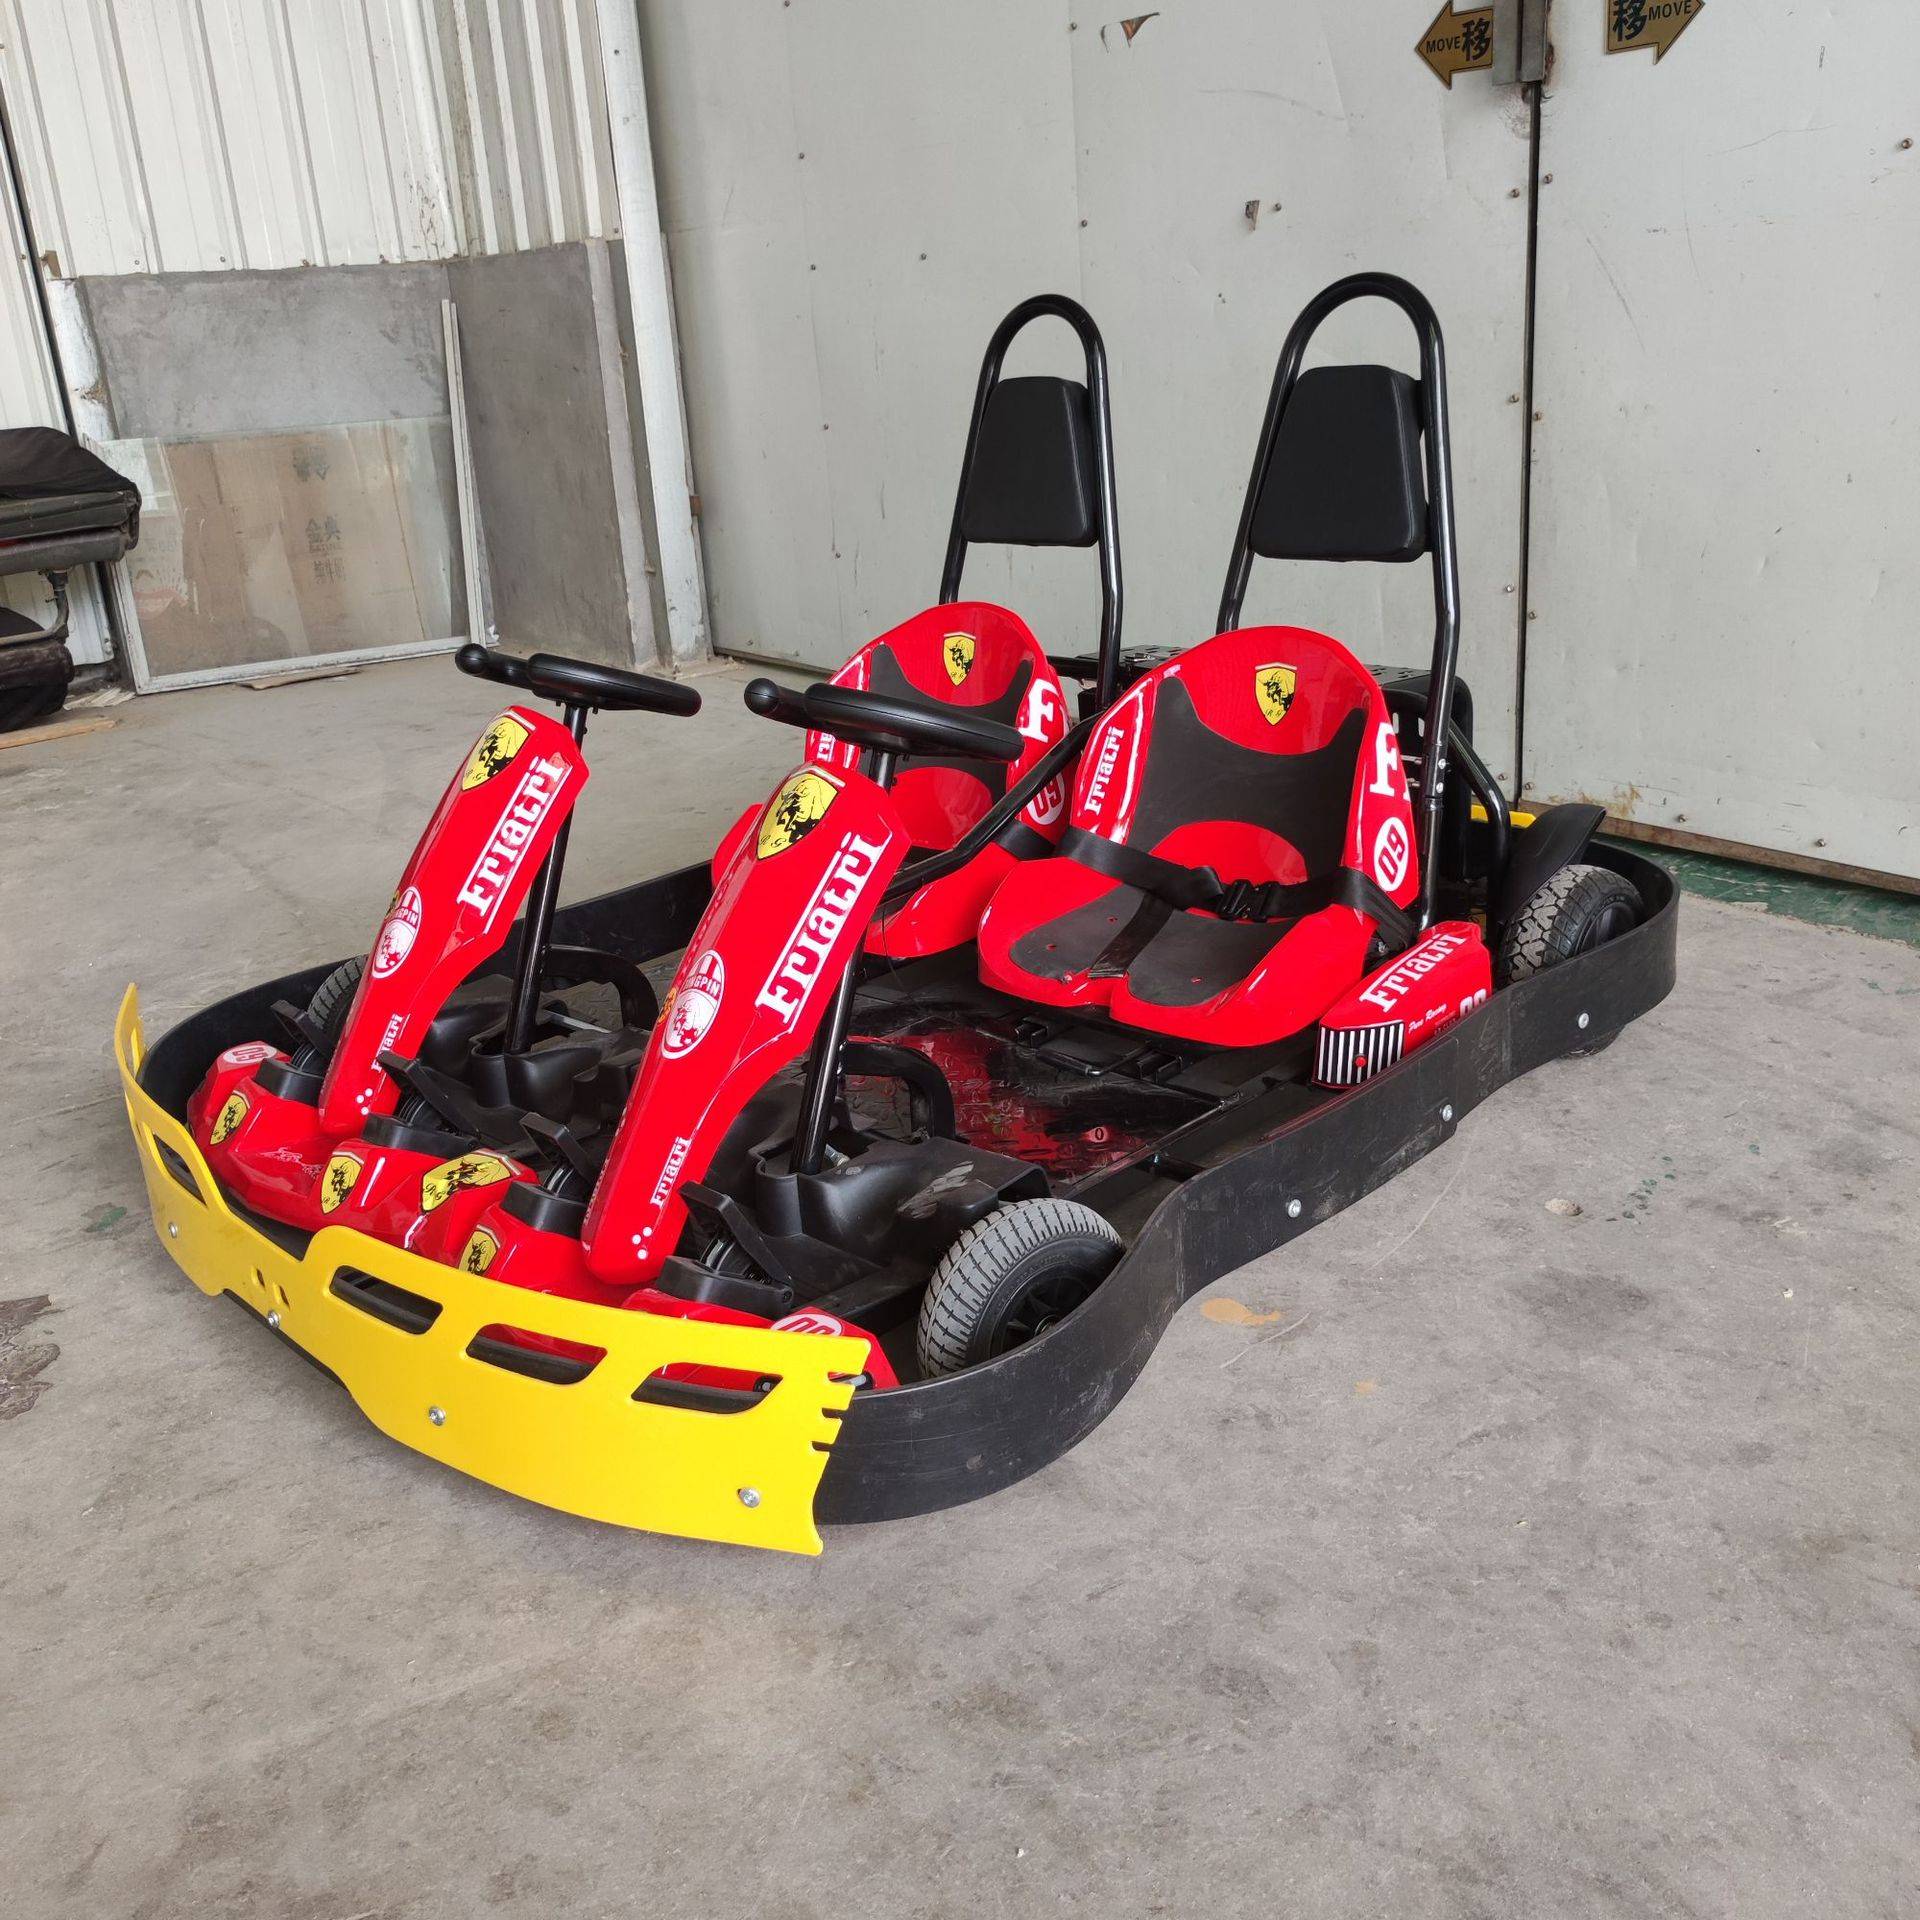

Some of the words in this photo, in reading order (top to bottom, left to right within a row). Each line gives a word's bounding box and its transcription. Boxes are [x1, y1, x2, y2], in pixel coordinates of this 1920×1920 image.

[1426, 36, 1460, 53] MOVE
[1462, 18, 1491, 61] 移
[1612, 0, 1647, 42] 移
[1649, 1, 1692, 20] MOVE
[1084, 726, 1124, 816] Friatri
[457, 755, 564, 917] Friatri
[1378, 824, 1406, 884] 09
[755, 832, 886, 1024] Friatri
[1359, 933, 1466, 1013] Friatri
